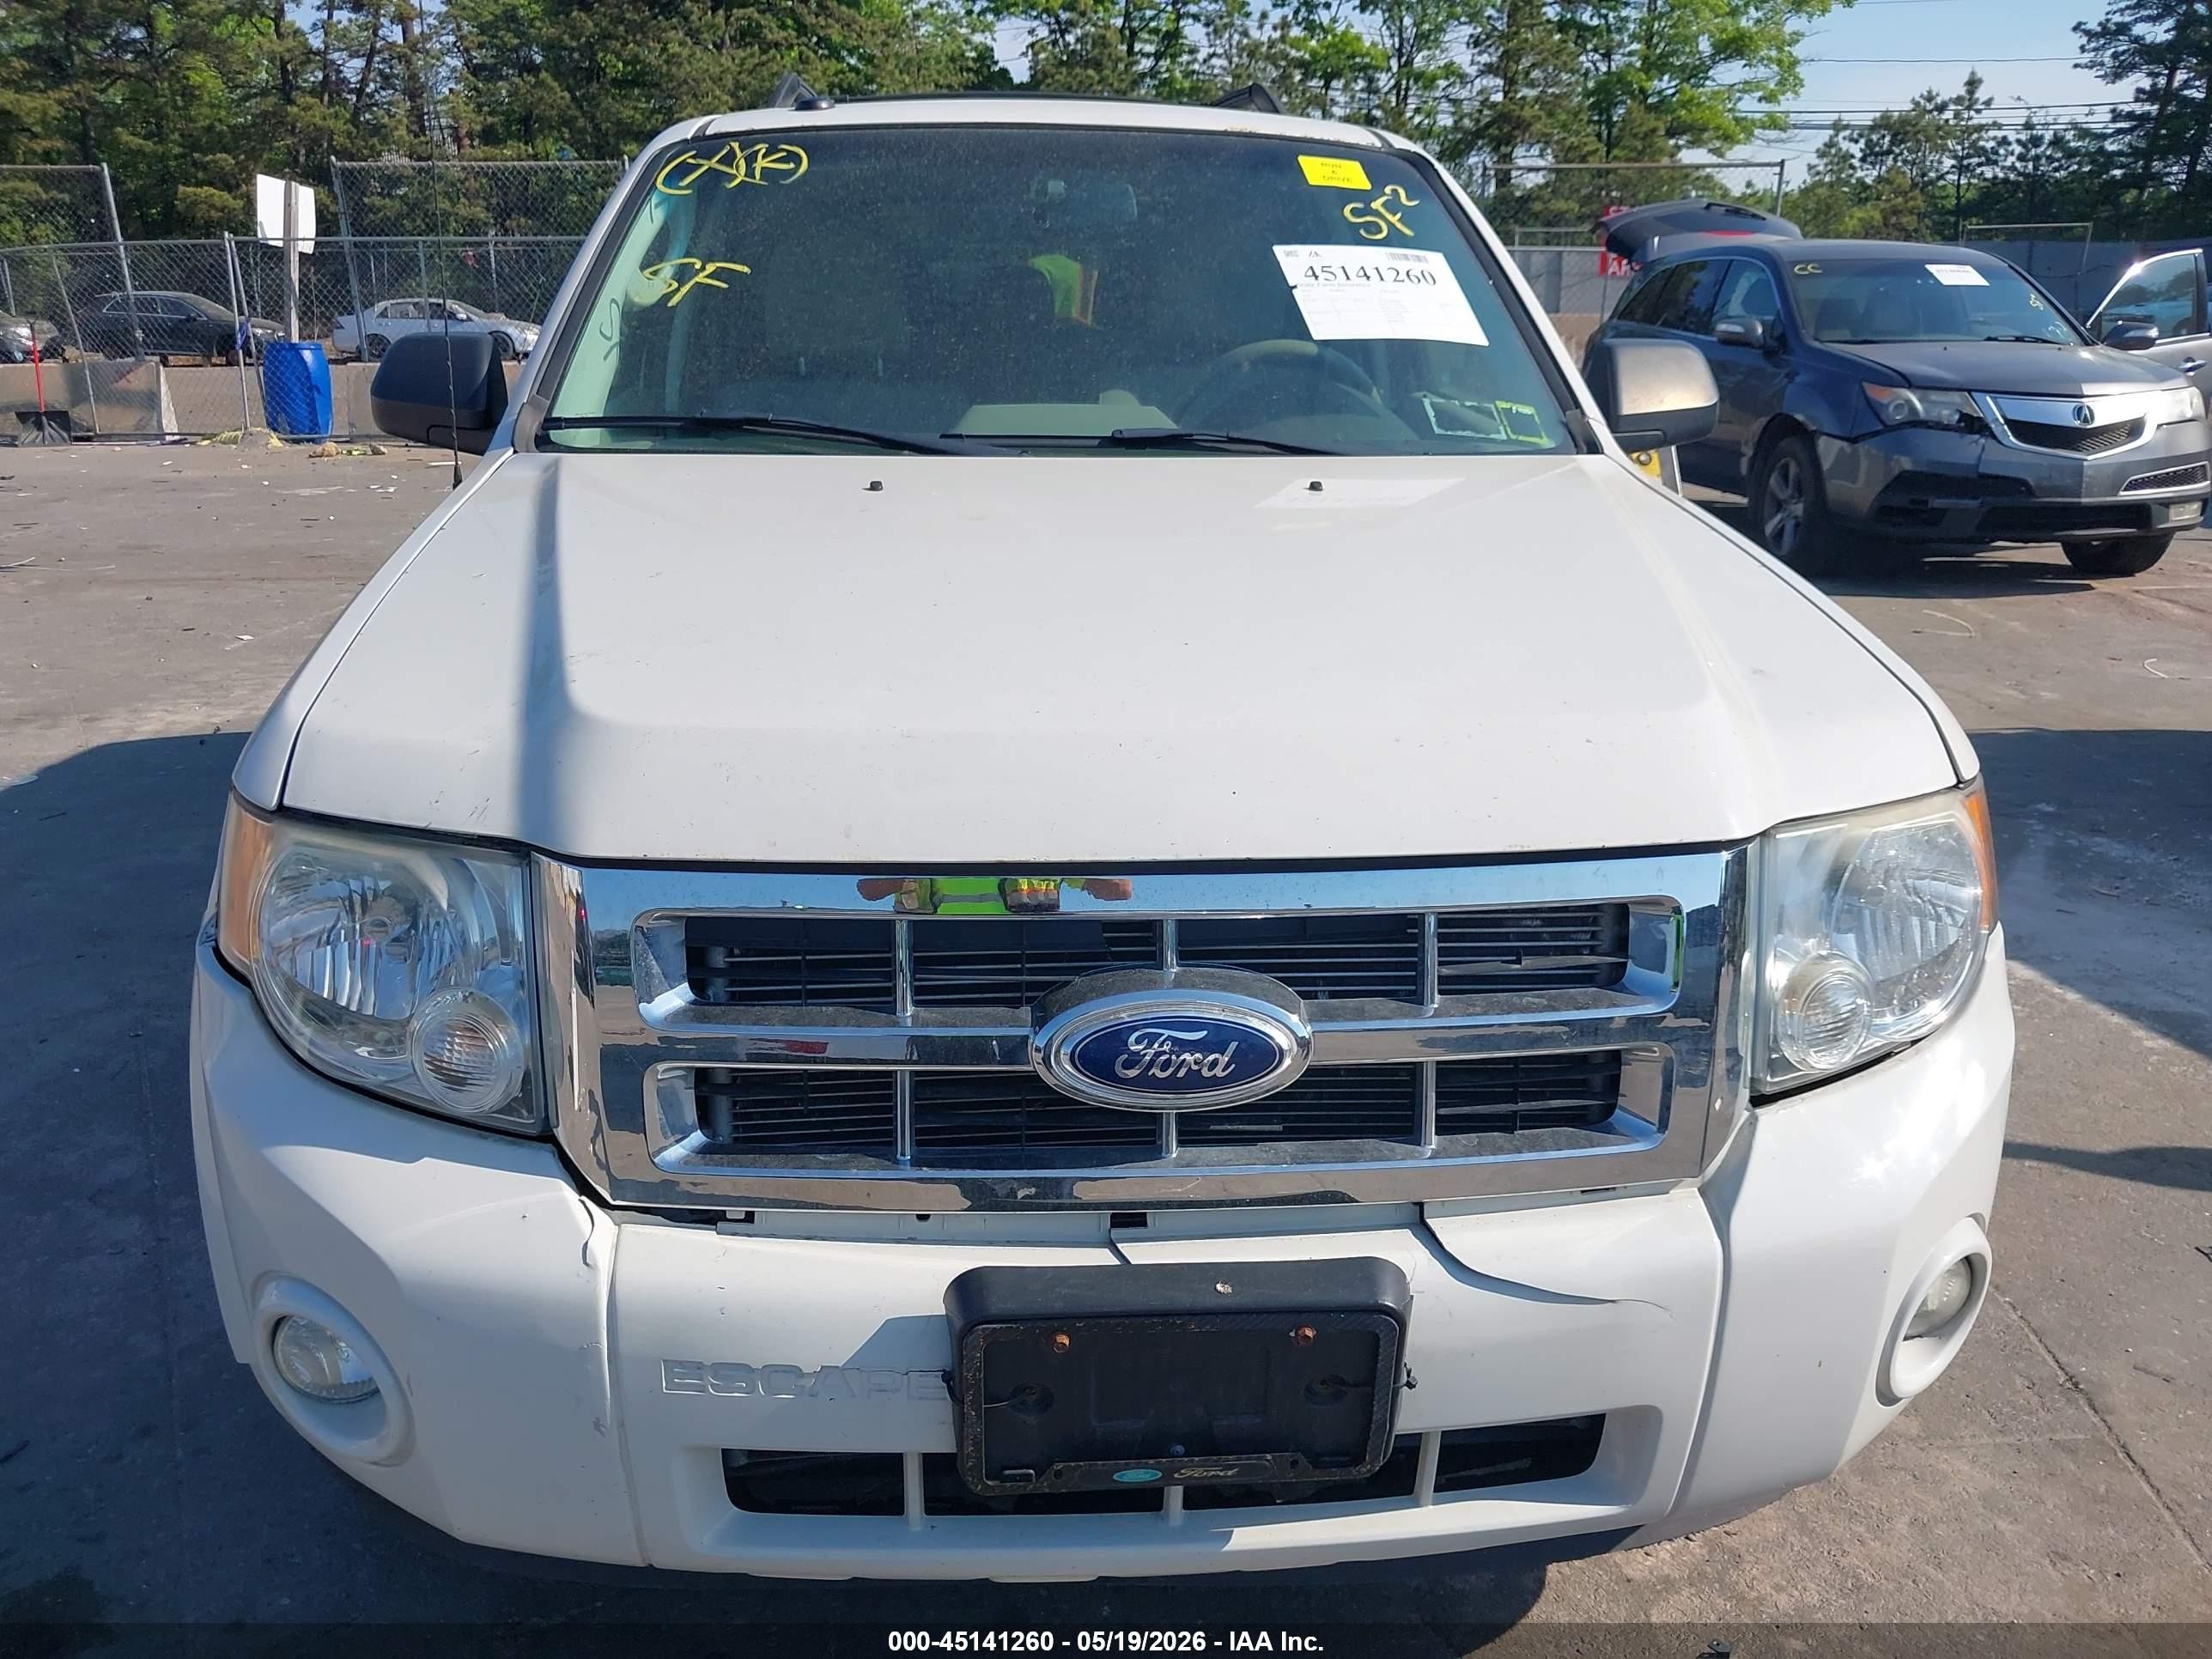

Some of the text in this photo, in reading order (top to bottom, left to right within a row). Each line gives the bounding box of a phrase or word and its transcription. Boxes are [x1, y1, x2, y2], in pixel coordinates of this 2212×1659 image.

[1304, 265, 1437, 286] 45141260
[1115, 1028, 1239, 1079] Ford
[660, 1359, 950, 1401] ESCAPE
[1174, 1467, 1239, 1479] Ford
